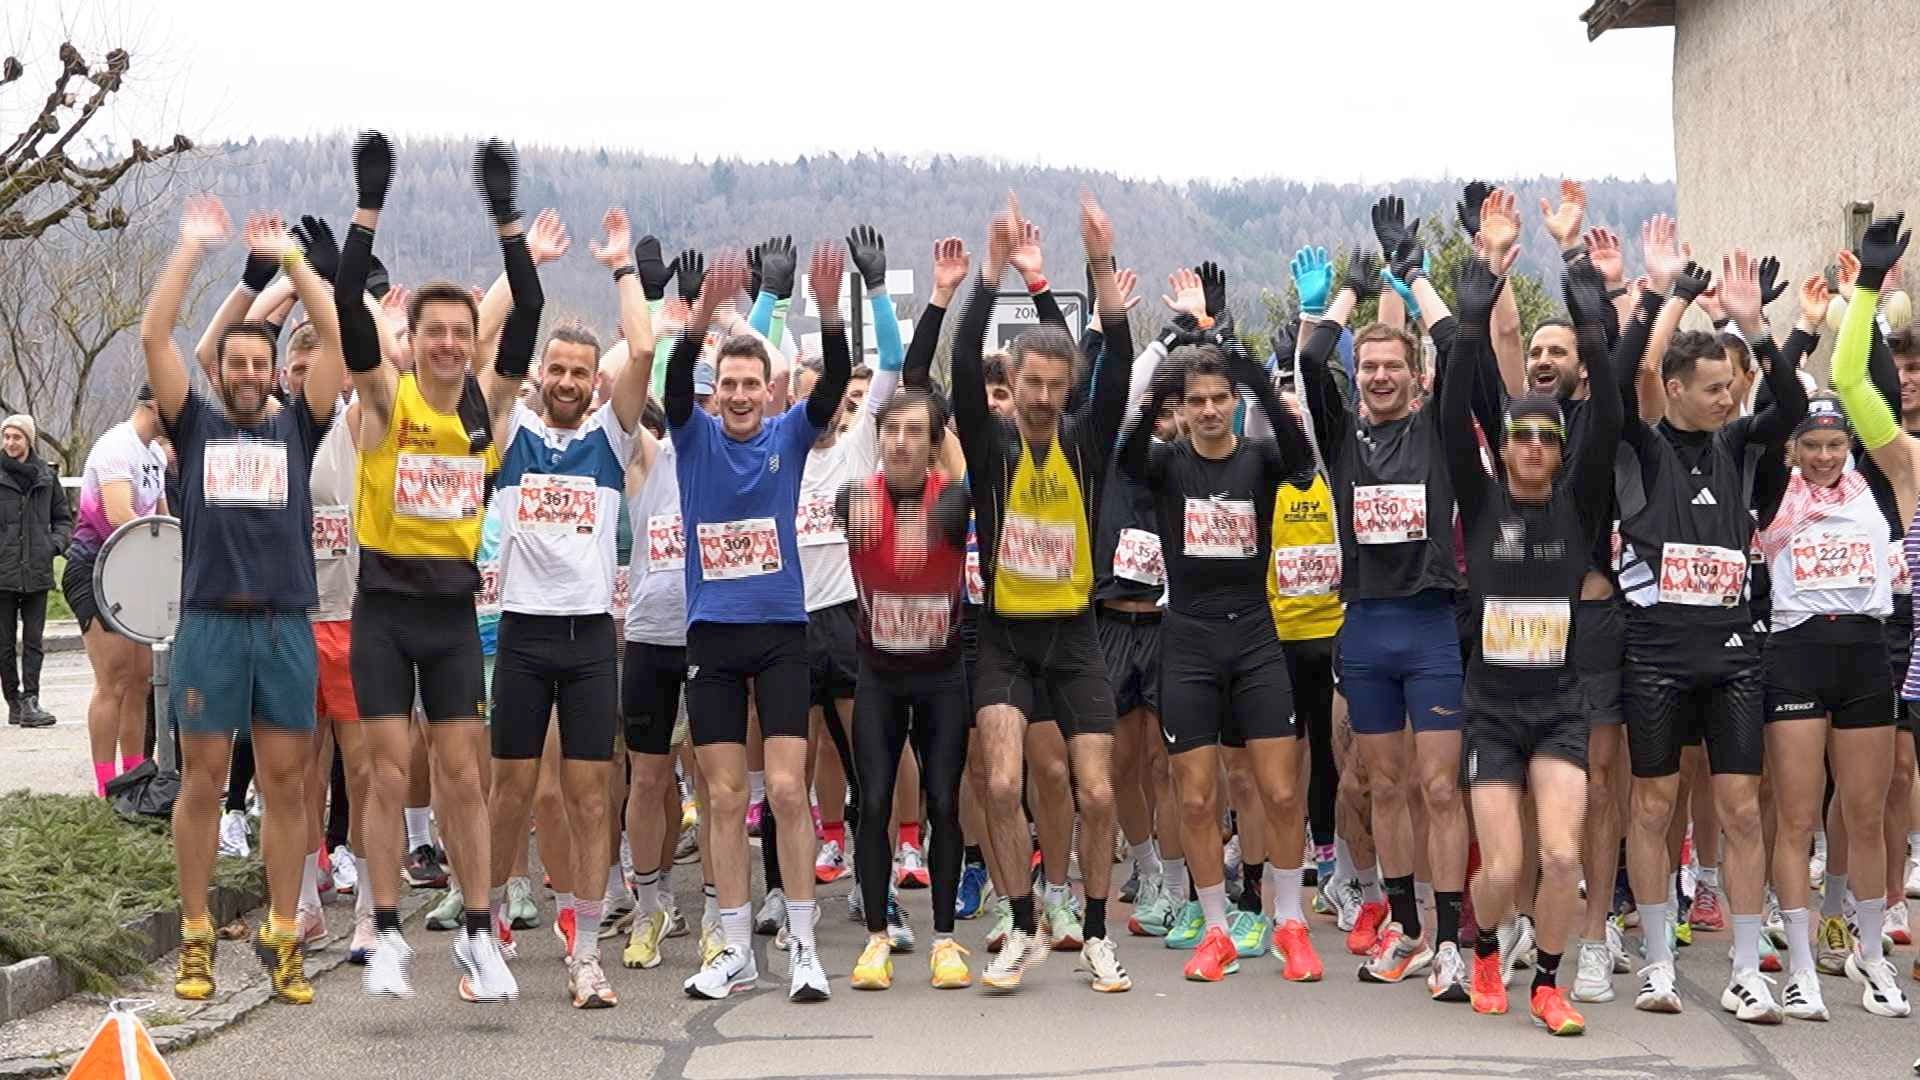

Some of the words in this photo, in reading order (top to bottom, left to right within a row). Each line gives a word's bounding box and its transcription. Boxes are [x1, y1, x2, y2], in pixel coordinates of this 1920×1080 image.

[543, 492, 569, 506] 361
[1375, 501, 1398, 515] 150
[724, 536, 750, 551] 309
[1820, 547, 1848, 560] 222
[1693, 563, 1718, 576] 104
